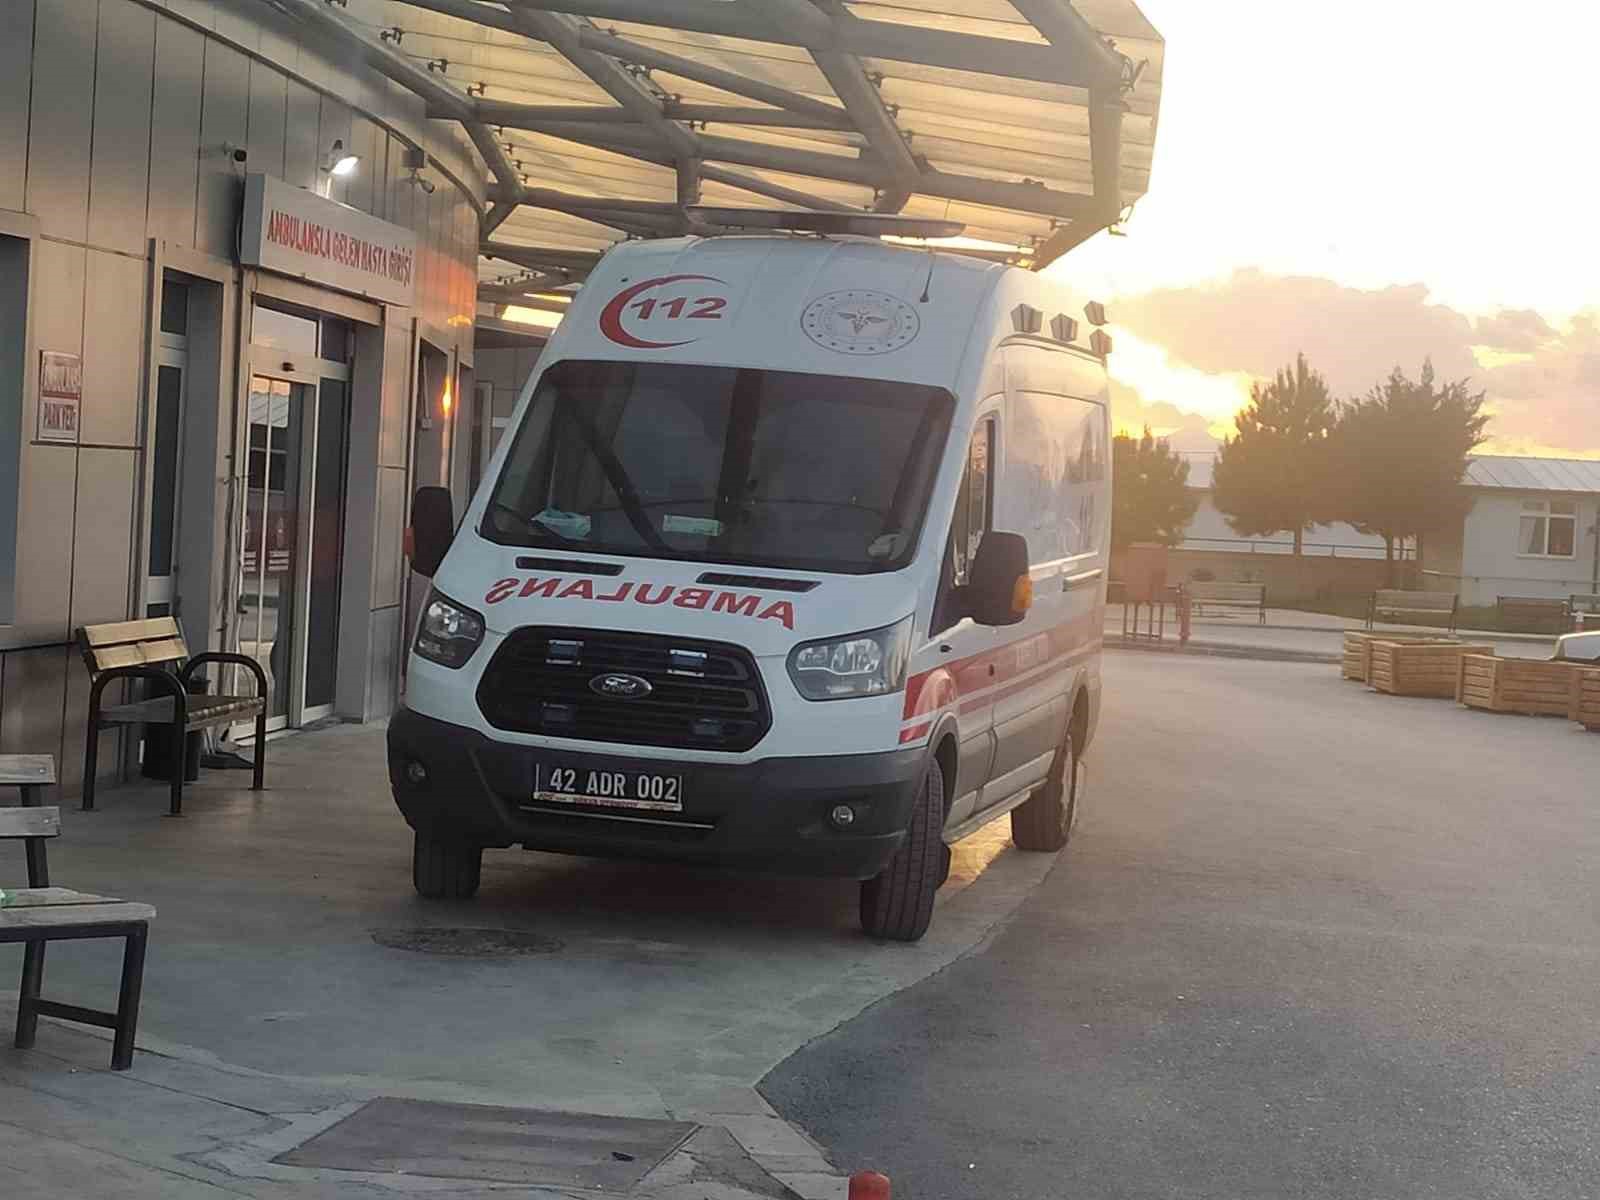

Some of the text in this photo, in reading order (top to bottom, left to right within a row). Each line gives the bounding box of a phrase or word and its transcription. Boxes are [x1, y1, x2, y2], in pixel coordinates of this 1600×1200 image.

[267, 209, 331, 260] AMBULANSLA
[333, 231, 360, 269] GELEN
[359, 239, 388, 277] HASTA
[630, 296, 727, 320] 112
[549, 768, 679, 802] 42 ADR 002
